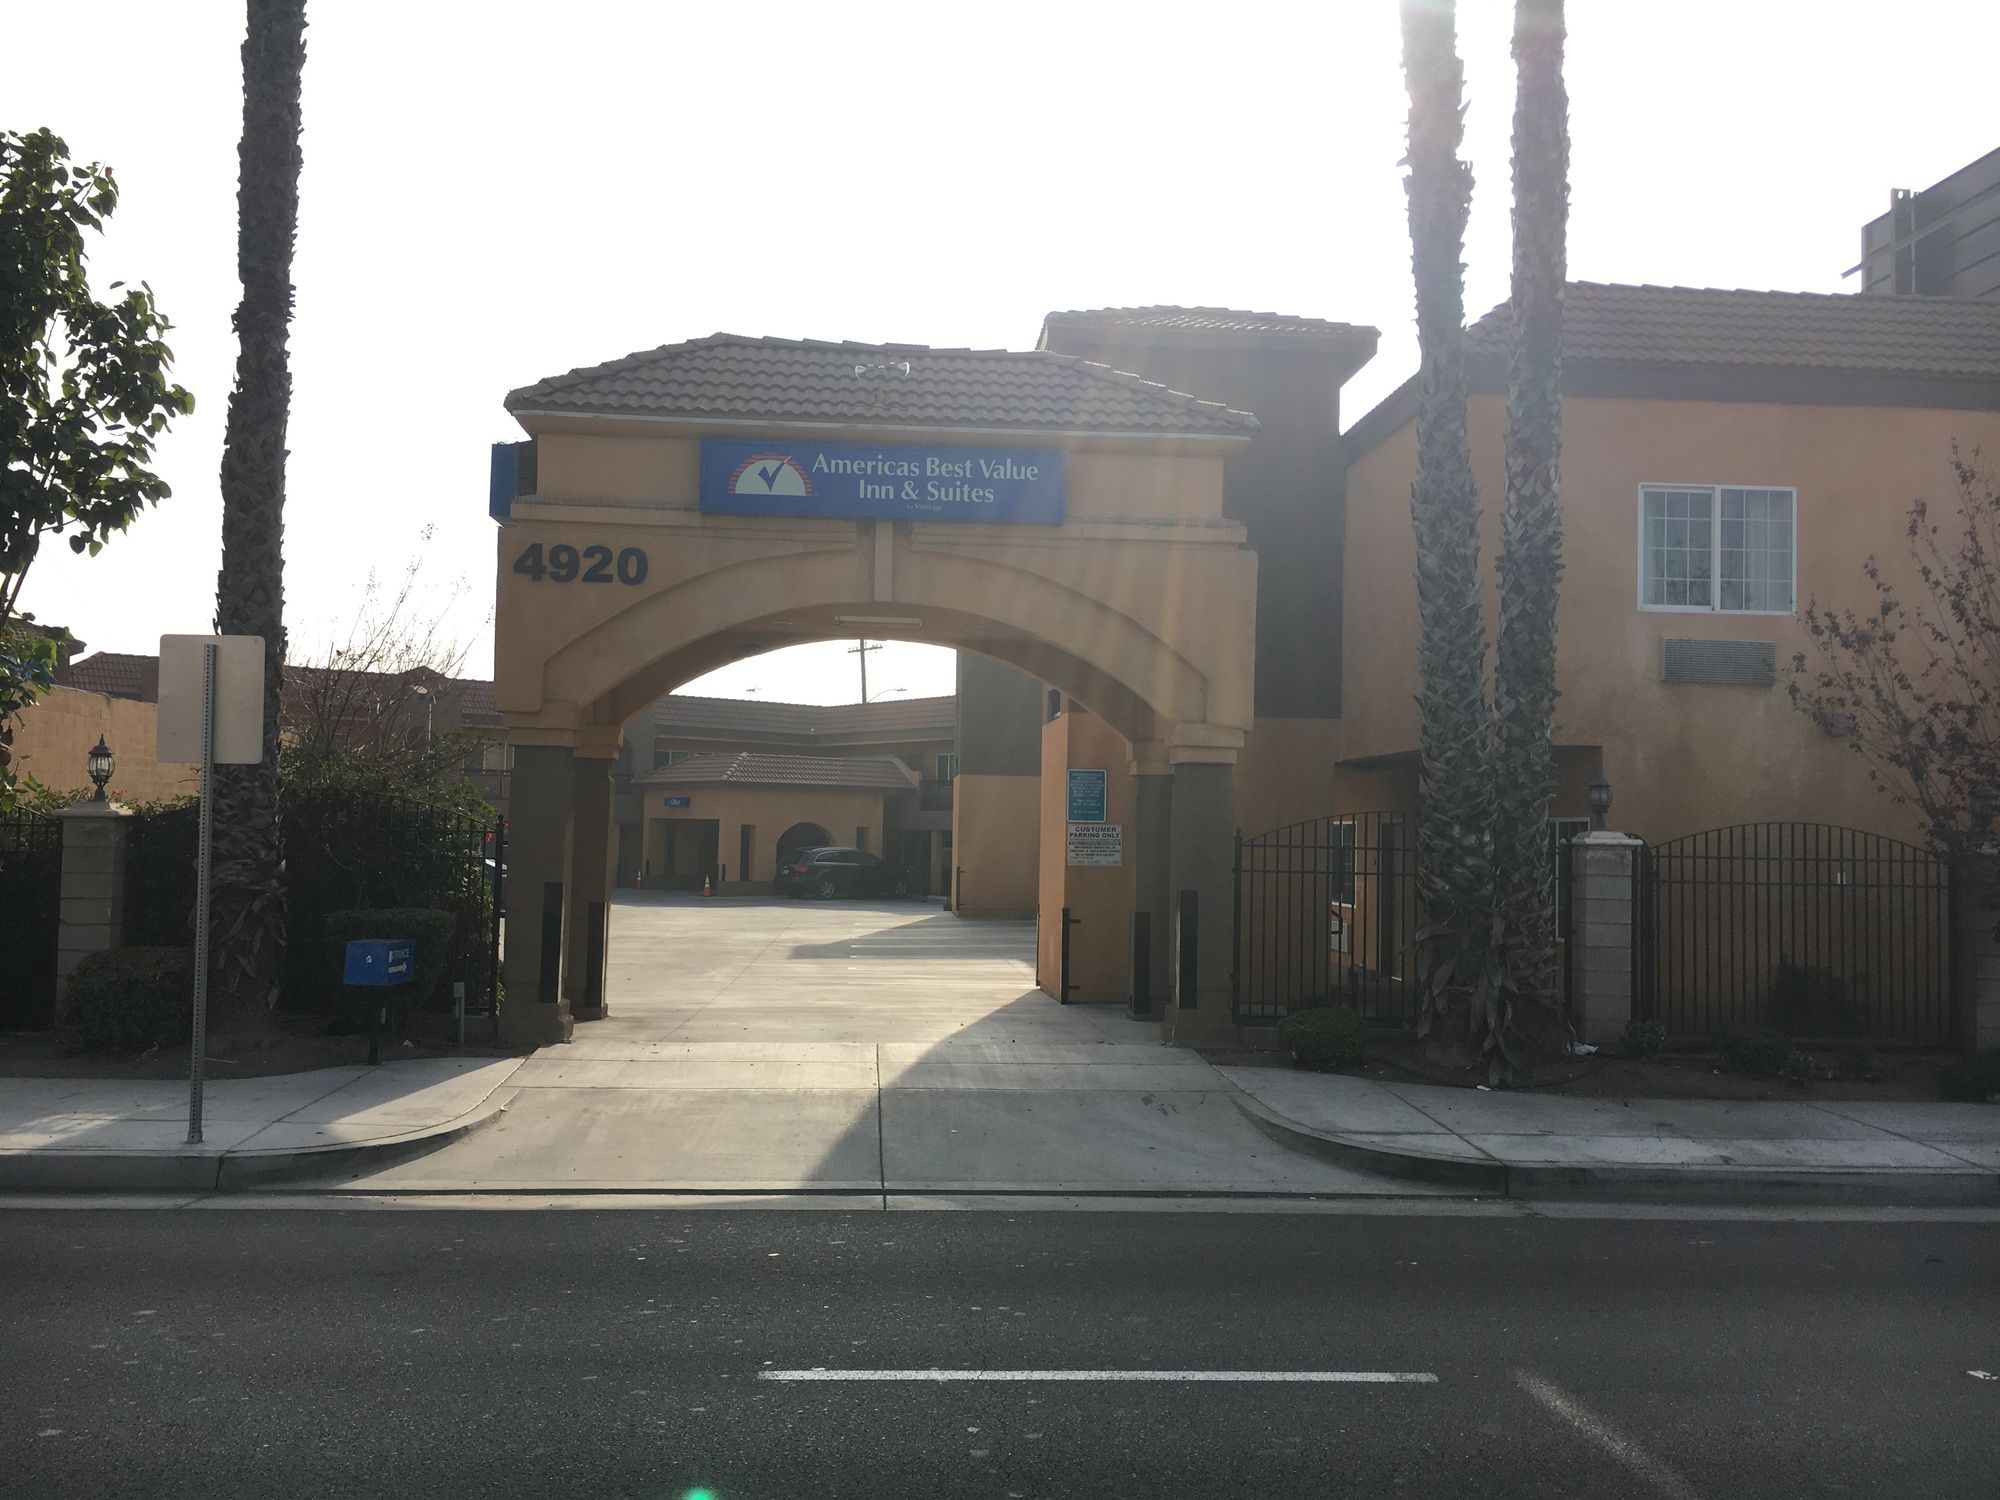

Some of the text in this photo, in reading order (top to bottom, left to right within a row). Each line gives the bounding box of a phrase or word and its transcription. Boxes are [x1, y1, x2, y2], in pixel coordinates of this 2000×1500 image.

[812, 453, 1039, 480] Americas Best Value
[859, 480, 994, 503] Inn & Suites
[513, 543, 648, 585] 4920
